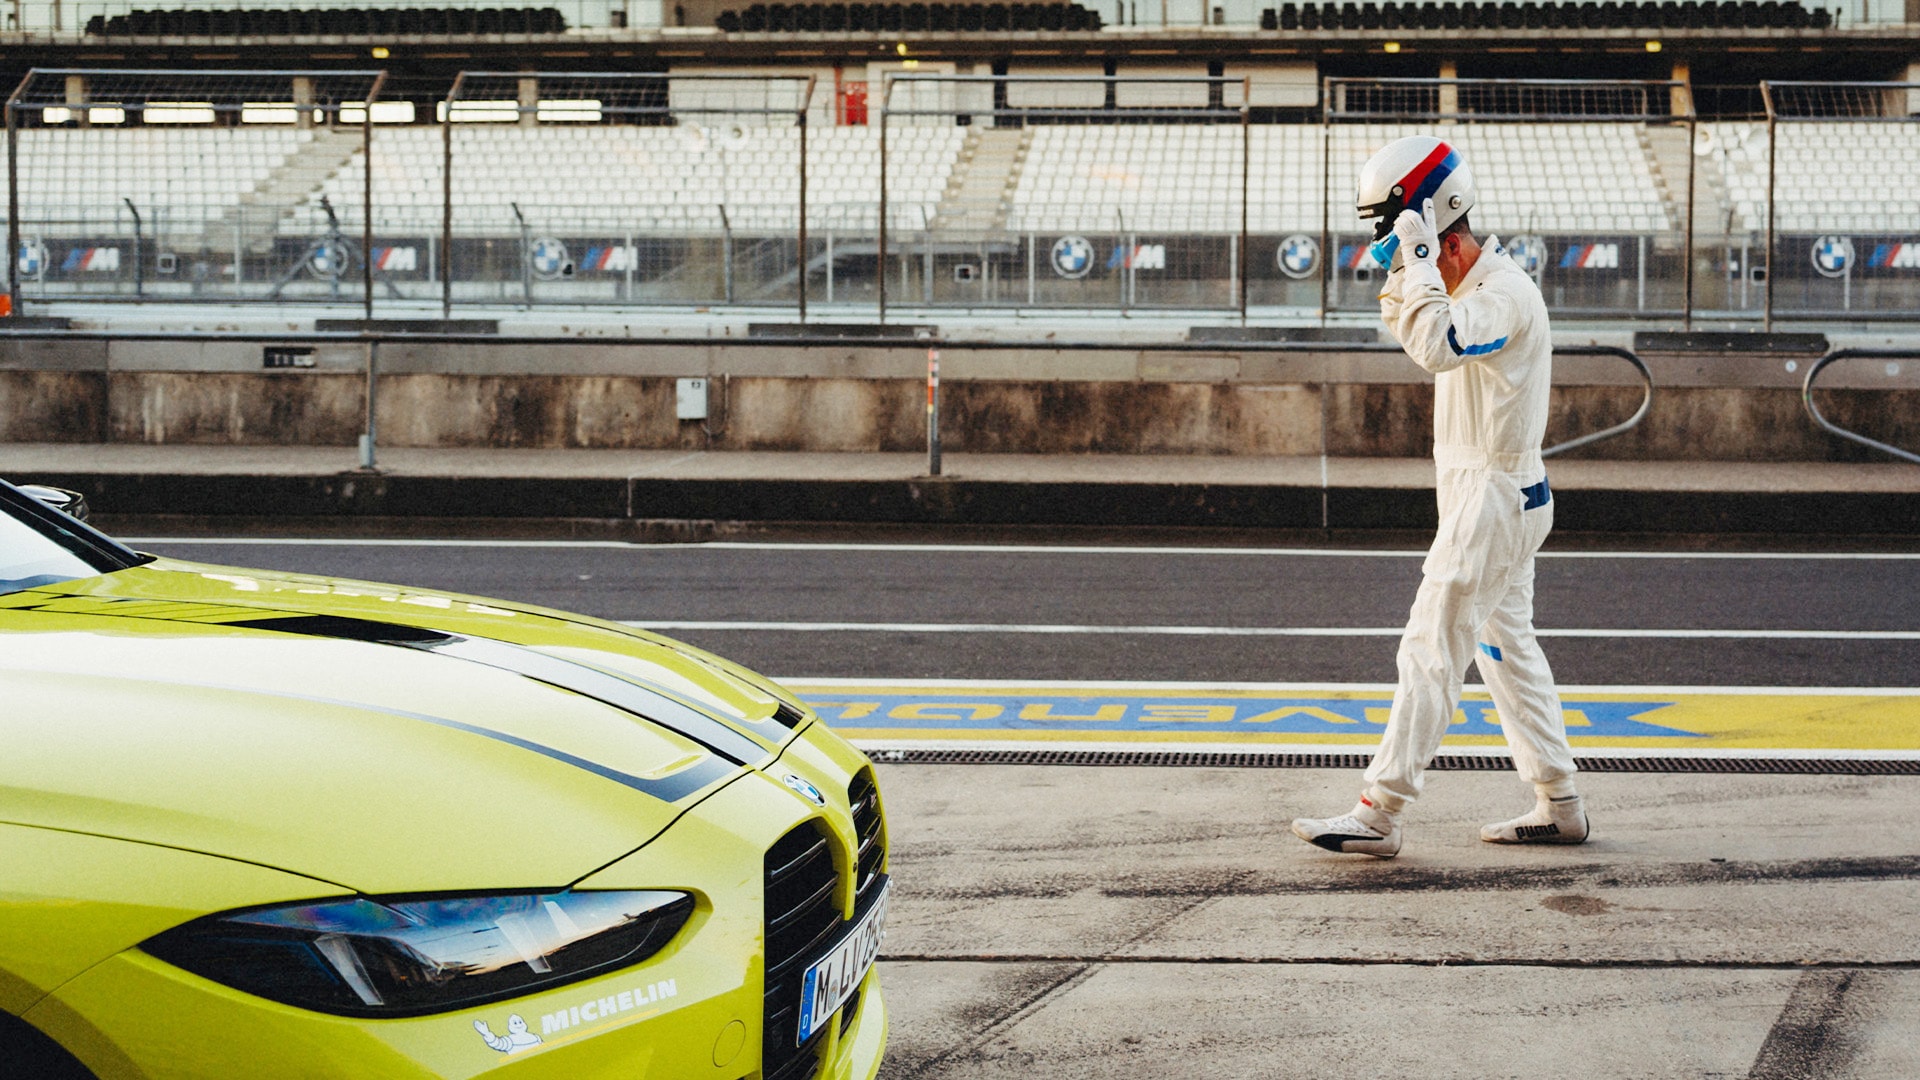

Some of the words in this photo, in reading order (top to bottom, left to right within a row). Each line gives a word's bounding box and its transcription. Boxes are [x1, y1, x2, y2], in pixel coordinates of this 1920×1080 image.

[1583, 243, 1618, 268] M
[1514, 823, 1560, 840] PUMA
[541, 978, 677, 1035] MICHELIN
[814, 962, 832, 1023] M
